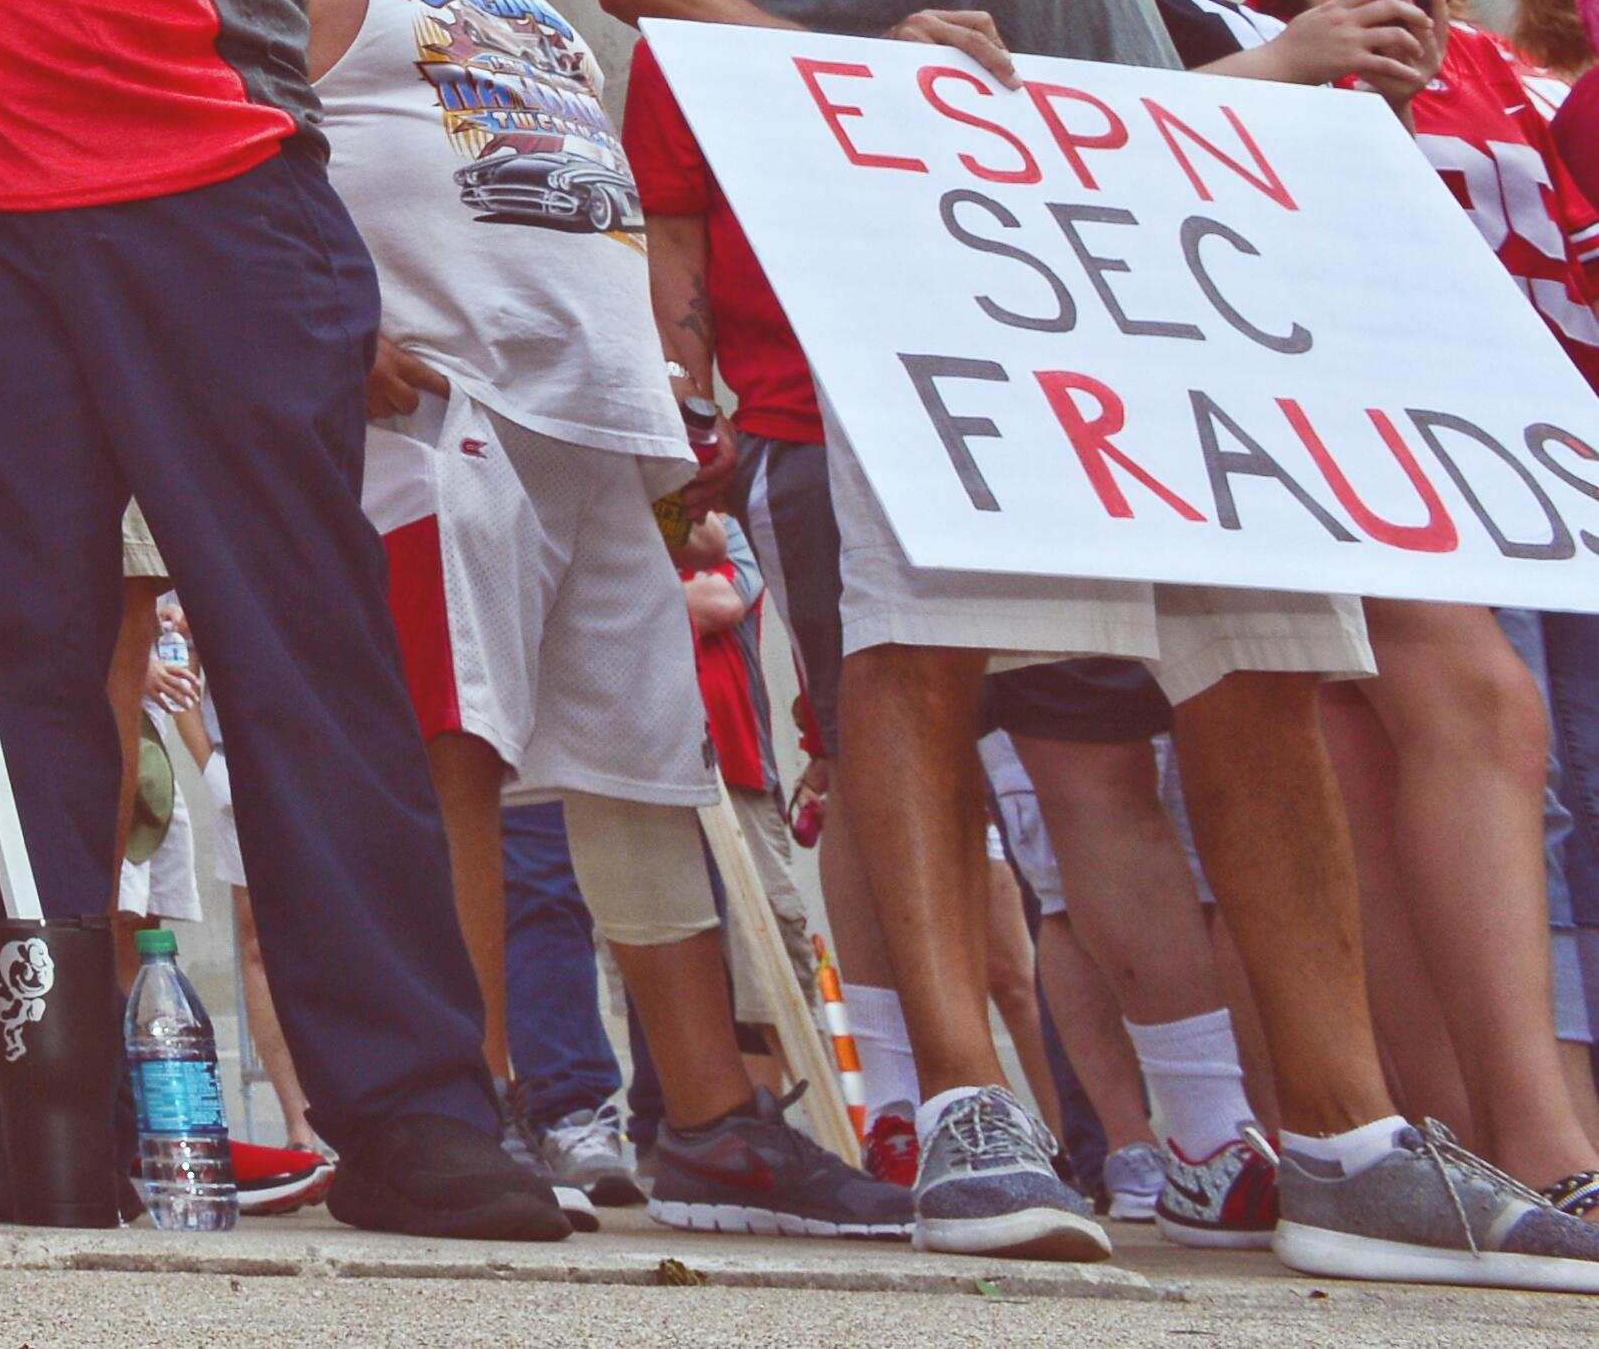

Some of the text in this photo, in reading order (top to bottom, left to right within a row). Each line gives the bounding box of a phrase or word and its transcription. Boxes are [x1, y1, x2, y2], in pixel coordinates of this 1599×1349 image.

[793, 56, 1298, 213] ESPN
[938, 188, 1313, 355] SEC
[898, 352, 1599, 562] FRAUDS
